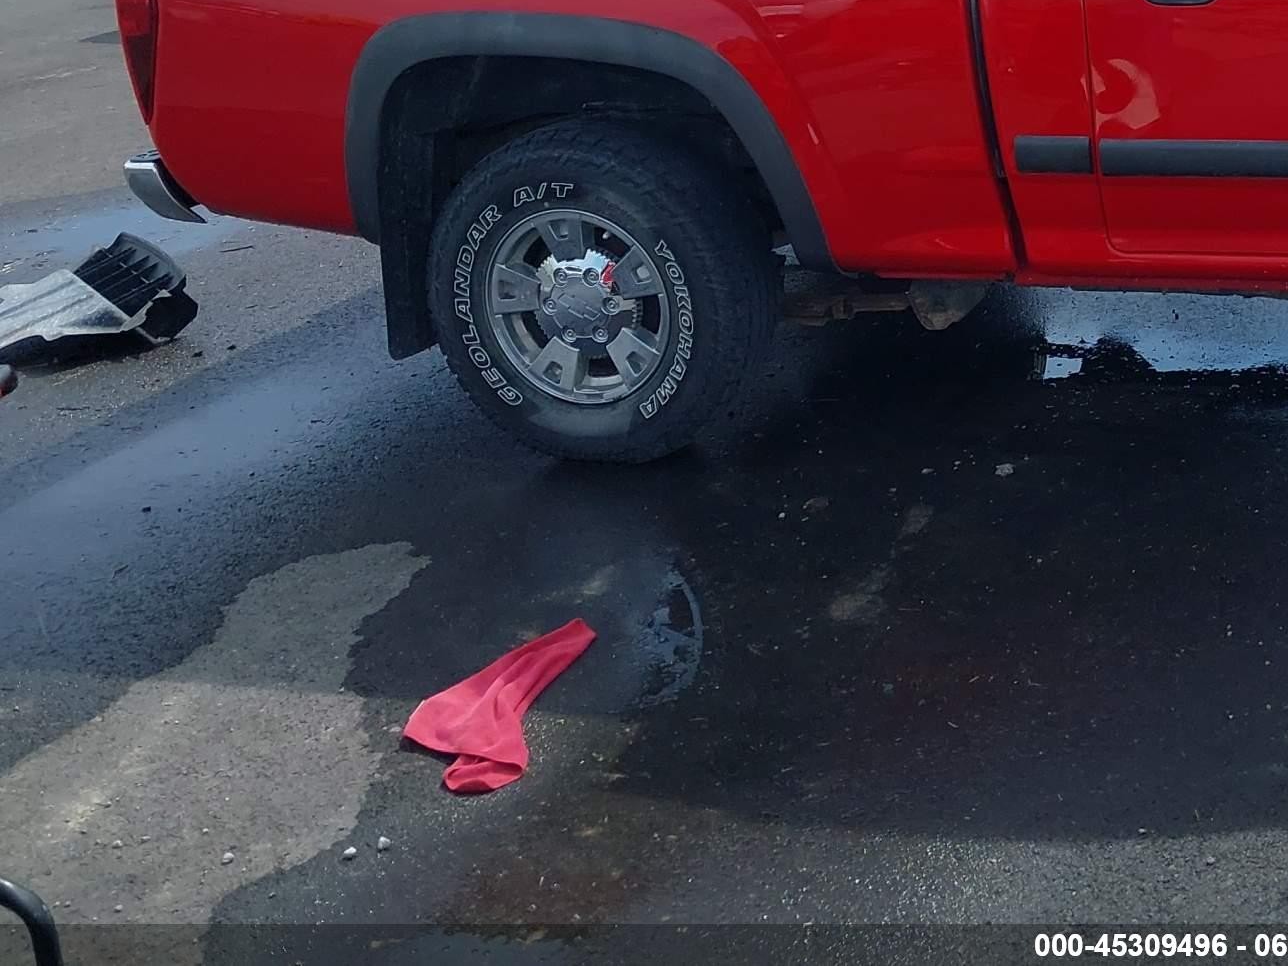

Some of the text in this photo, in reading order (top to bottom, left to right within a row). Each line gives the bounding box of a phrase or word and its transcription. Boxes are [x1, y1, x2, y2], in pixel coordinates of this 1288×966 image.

[452, 182, 574, 407] GEOLANDAR A/T
[639, 239, 695, 419] YOKOHAMA
